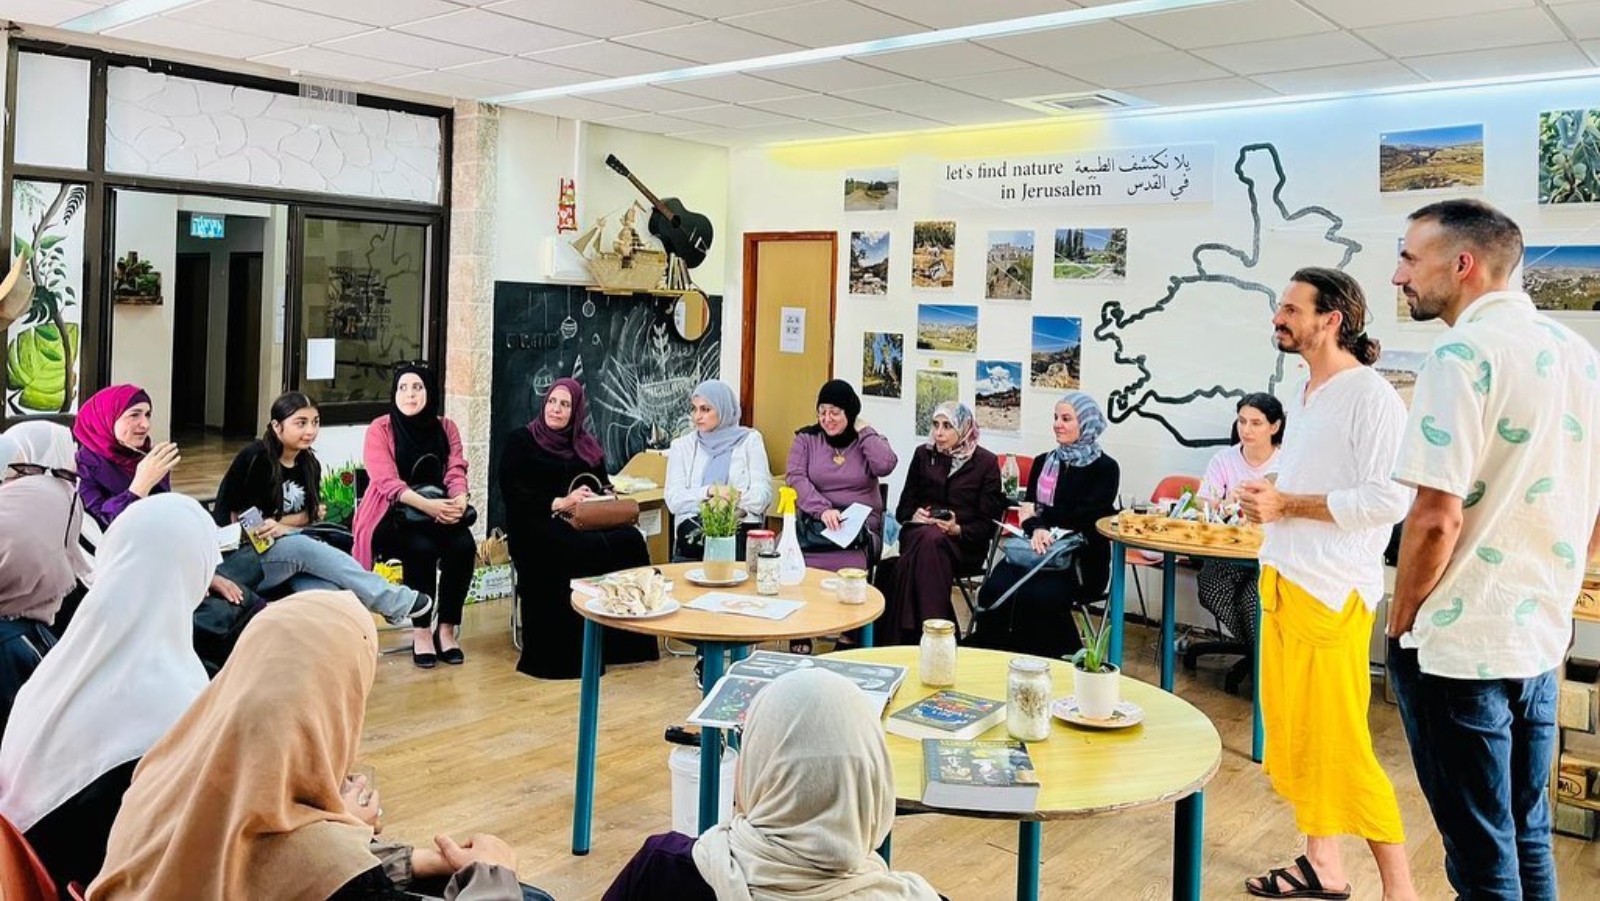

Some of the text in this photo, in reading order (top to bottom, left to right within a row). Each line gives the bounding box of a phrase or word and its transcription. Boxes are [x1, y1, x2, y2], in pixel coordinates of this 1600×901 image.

[945, 161, 1064, 181] let's find nature
[1074, 148, 1191, 180] يلا نكتشف الطبيعة
[1000, 180, 1102, 202] in Jerusalem
[1127, 173, 1190, 201] في القدس
